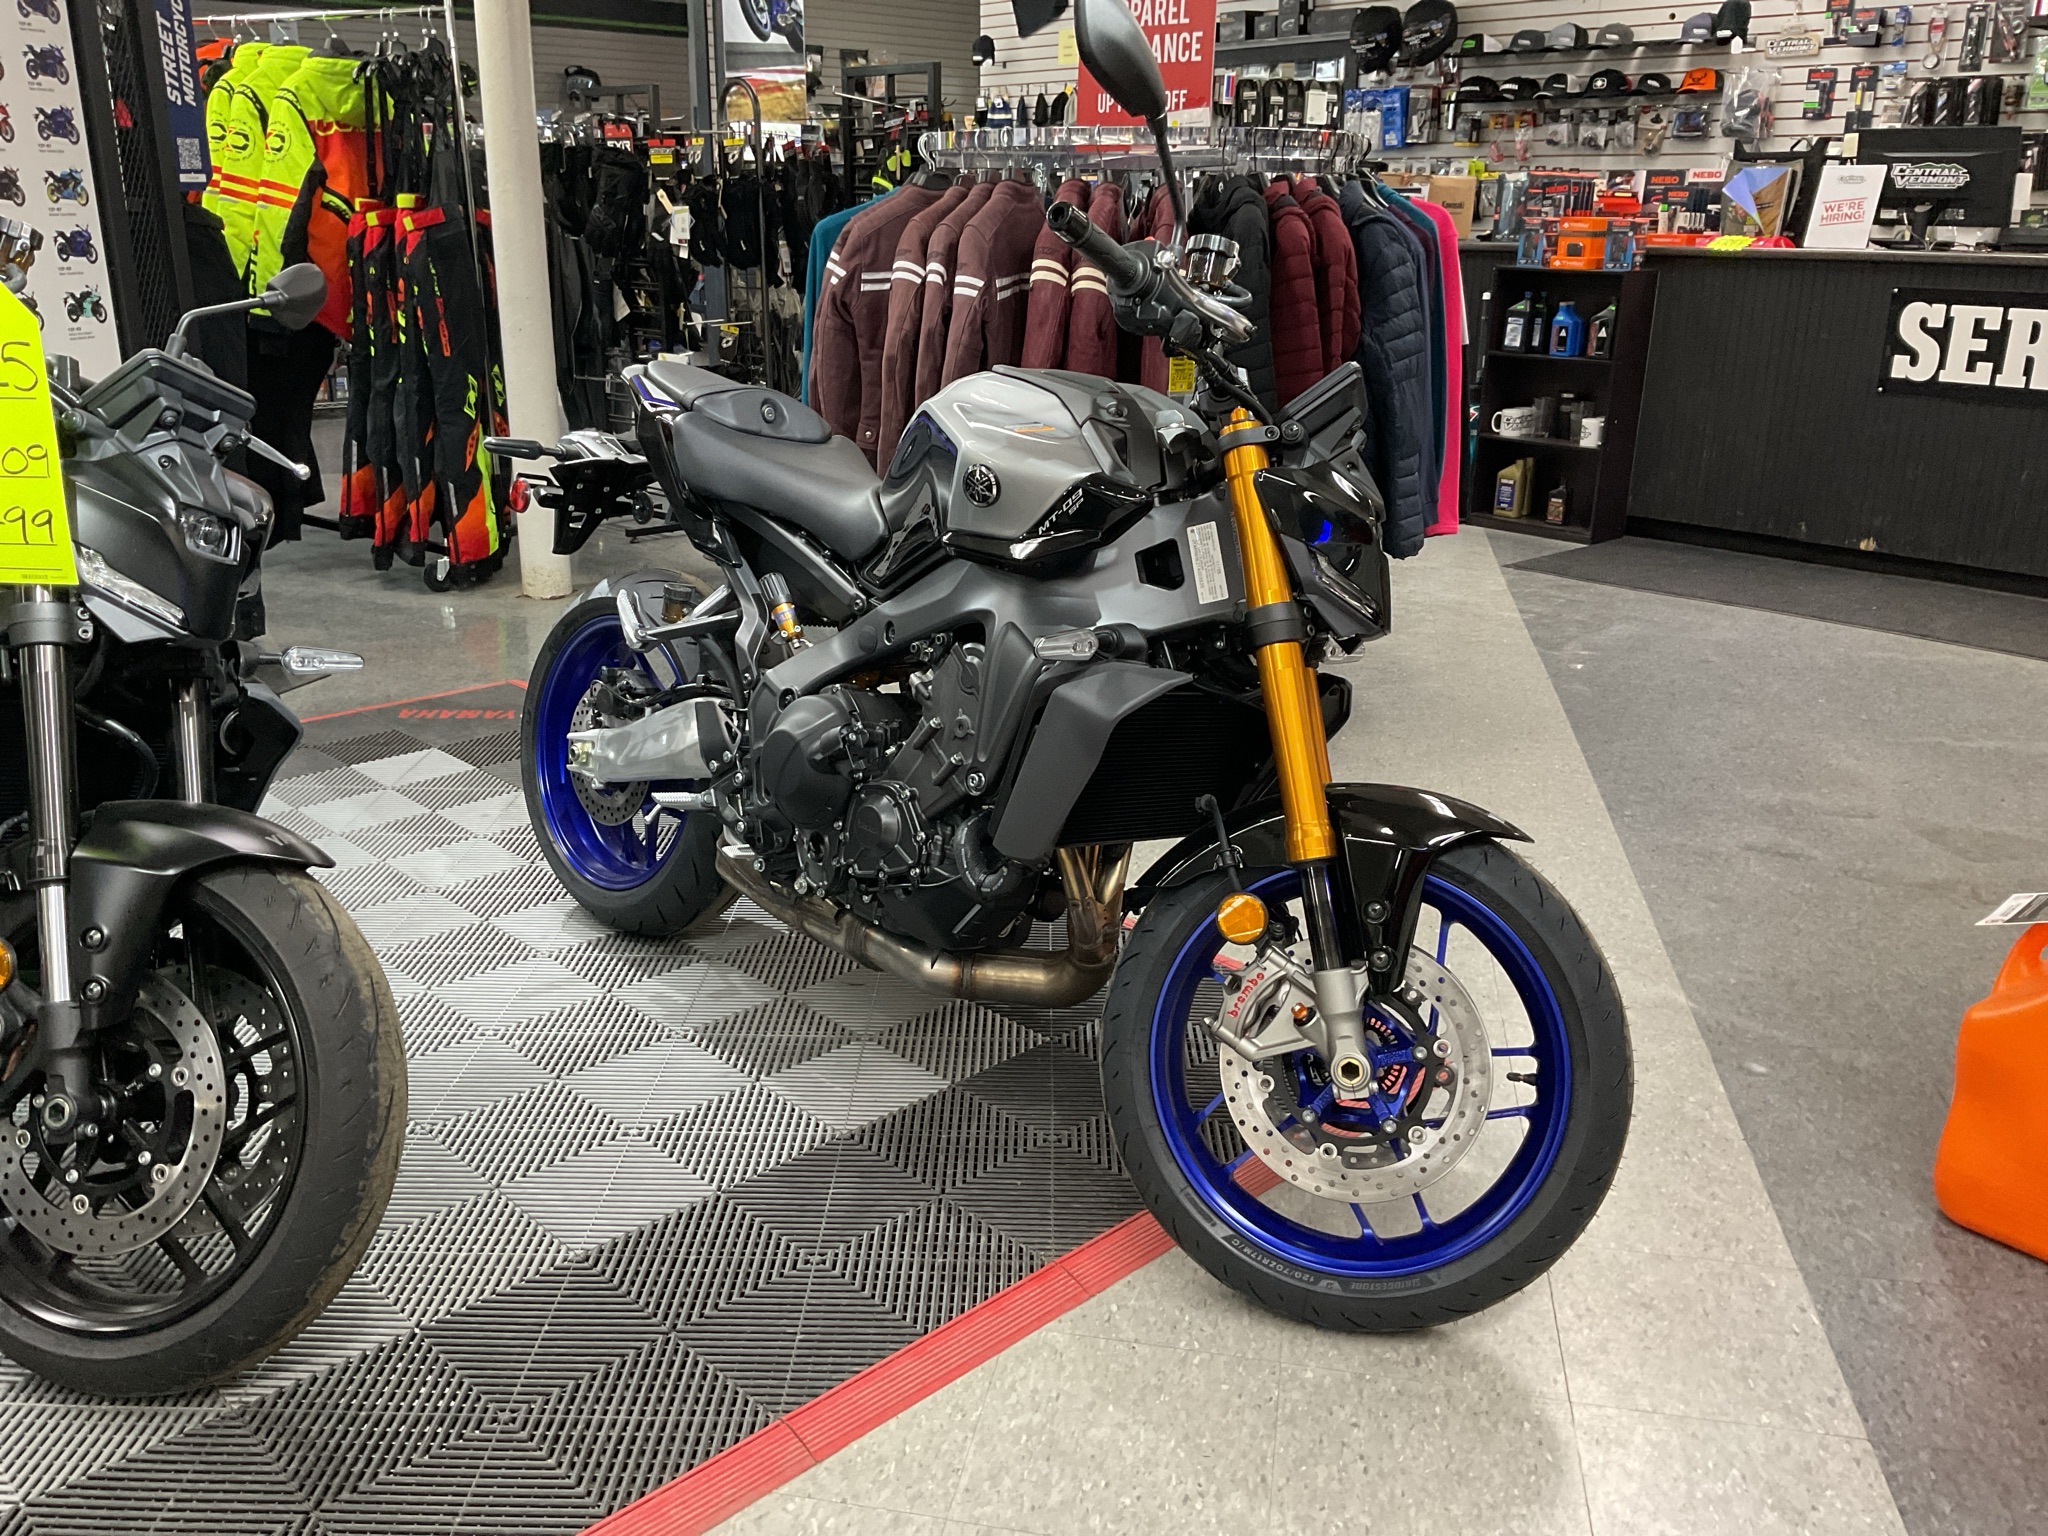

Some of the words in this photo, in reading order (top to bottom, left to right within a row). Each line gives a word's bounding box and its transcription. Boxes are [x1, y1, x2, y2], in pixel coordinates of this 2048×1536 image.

[1124, 0, 1190, 27] PAREL
[1151, 31, 1203, 64] ANCE
[1767, 38, 1810, 48] CENTRAL
[1768, 45, 1816, 55] VERMONT
[156, 10, 182, 105] STREET
[1098, 93, 1114, 113] UP
[1693, 171, 1722, 179] NEBO
[1893, 165, 1958, 176] CENTRAL
[1651, 176, 1679, 184] NEBO
[1896, 175, 1966, 186] VERMONT
[1545, 185, 1569, 193] NEBO
[1824, 200, 1864, 213] WE'RE
[1820, 210, 1865, 224] HIRING!
[0, 341, 38, 392] 5
[1038, 487, 1083, 536] MT-09
[1068, 497, 1084, 516] SP
[0, 505, 54, 545] 99
[1226, 972, 1265, 1018] brembo
